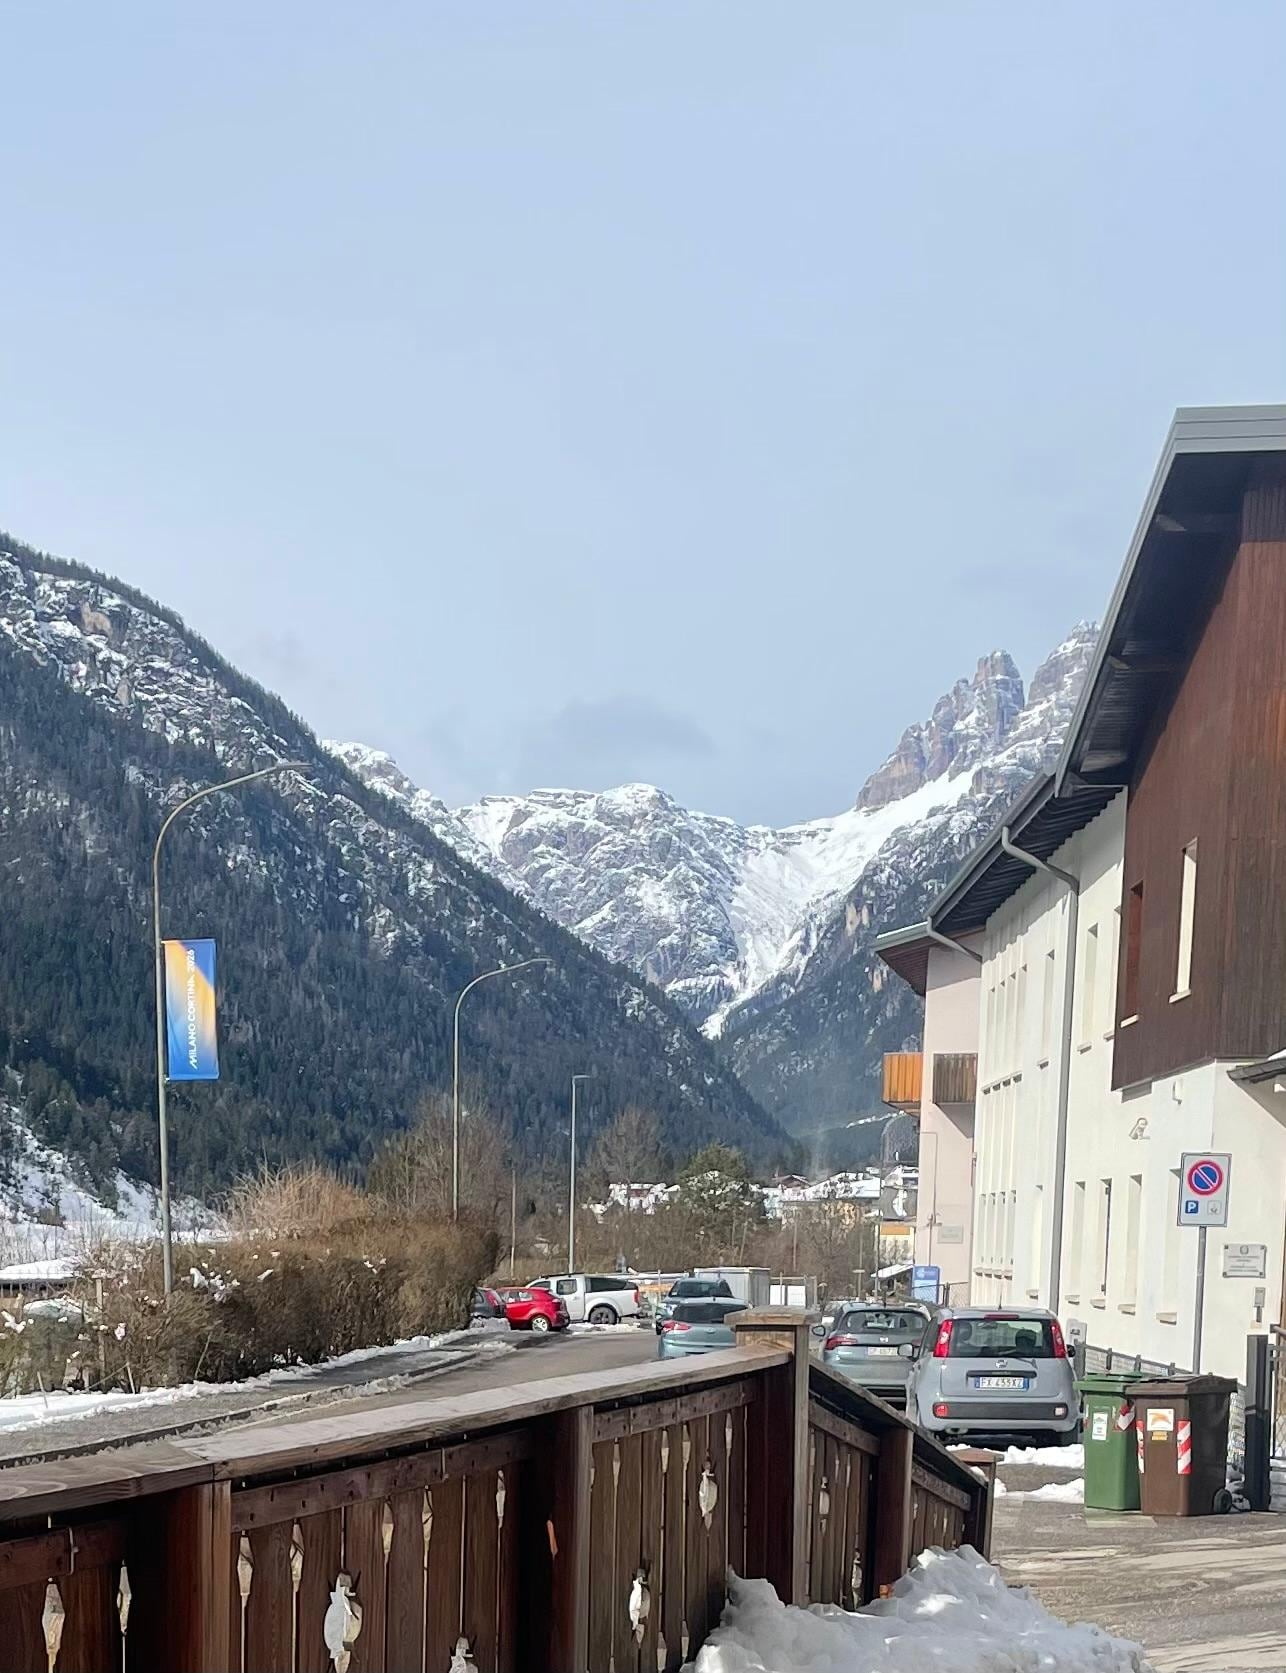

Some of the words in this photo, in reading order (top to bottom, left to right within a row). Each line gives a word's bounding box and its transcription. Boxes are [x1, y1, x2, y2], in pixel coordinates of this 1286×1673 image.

[187, 949, 195, 972] 2026
[187, 974, 195, 1021] CORTINA
[188, 1023, 198, 1070] MILANO
[1187, 1201, 1197, 1213] P
